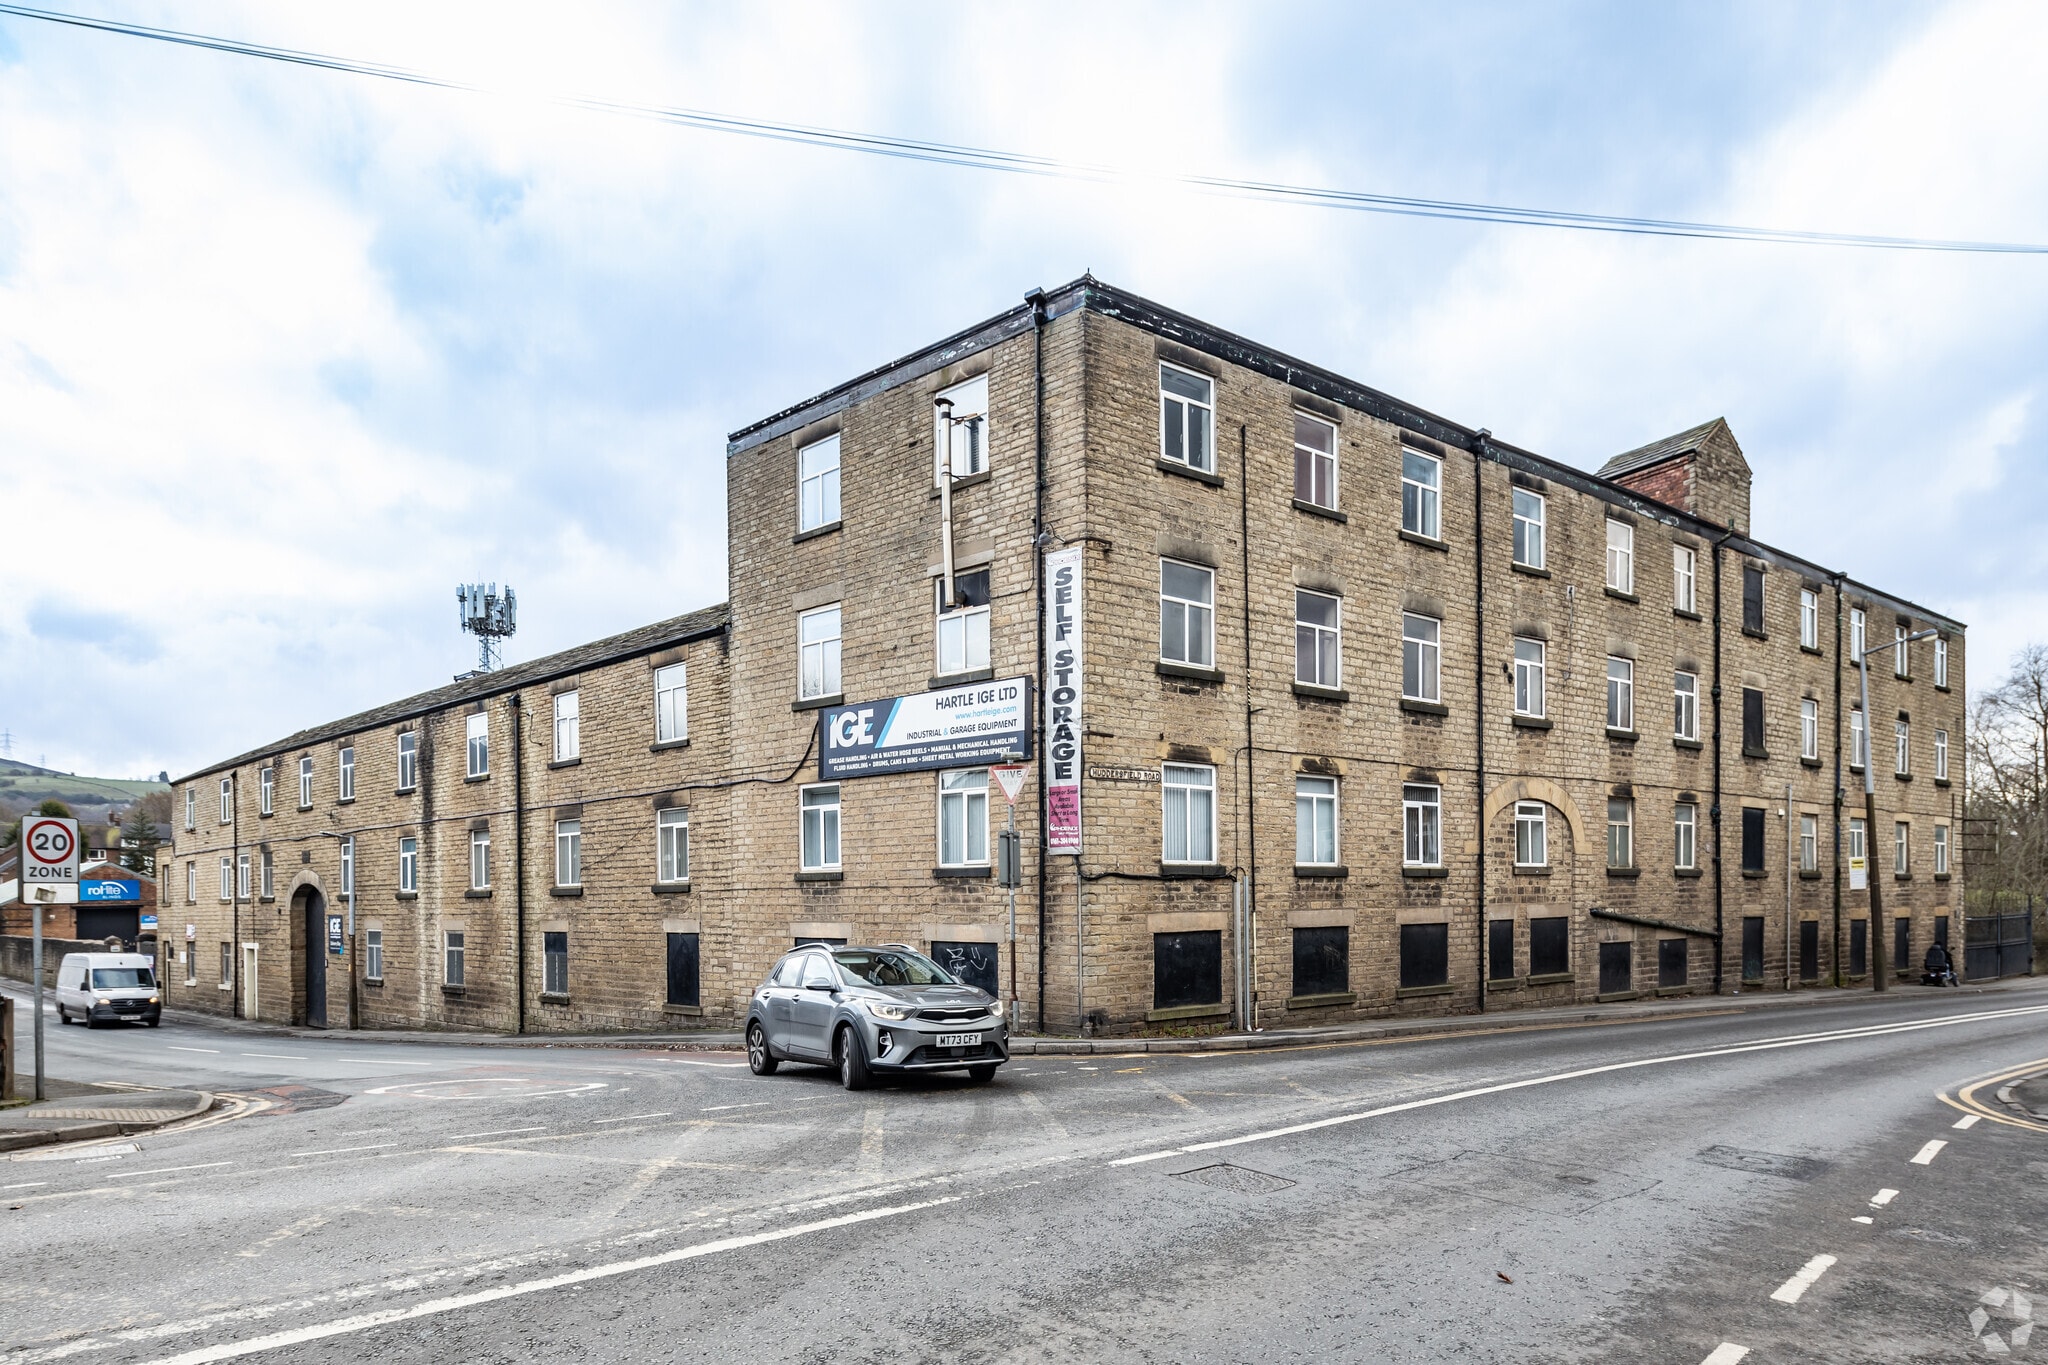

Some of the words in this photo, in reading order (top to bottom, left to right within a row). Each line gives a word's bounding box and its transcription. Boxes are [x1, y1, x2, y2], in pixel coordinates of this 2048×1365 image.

[1054, 566, 1073, 642] SELF
[936, 693, 974, 710] HARTLE
[977, 690, 995, 704] IGE
[998, 686, 1018, 701] LTD
[955, 705, 1017, 720] www.hartleige.com
[1051, 649, 1077, 780] STORAGE
[830, 708, 874, 749] IGE
[906, 729, 942, 740] INDUSTRIAL
[943, 728, 949, 736] &
[949, 724, 976, 735] GARAGE
[977, 719, 1017, 731] EQUIPMENT
[828, 757, 846, 765] GREASE
[845, 754, 868, 763] HANDLING
[870, 752, 879, 760] AIR
[883, 749, 899, 758] WATER
[899, 748, 912, 756] HOSE
[911, 746, 928, 755] REELS
[930, 743, 952, 753] MANUAL
[956, 739, 990, 750] MECHANICAL
[989, 736, 1018, 746] HANDLING
[833, 763, 846, 772] FLUID
[846, 761, 869, 769] HANDLING
[889, 757, 903, 765] CANS
[906, 755, 919, 763] BINS
[921, 754, 938, 763] SHEET
[937, 752, 955, 761] METAL
[955, 749, 980, 759] WORKING
[979, 746, 1011, 756] EQUIPMENT
[1000, 770, 1023, 778] GIVE
[1093, 769, 1141, 780] HUDDERSFIELD
[1144, 772, 1160, 780] ROAD
[35, 833, 67, 851] 20
[29, 866, 72, 878] ZONE
[940, 1036, 962, 1046] MT73
[963, 1034, 979, 1044] CFY
